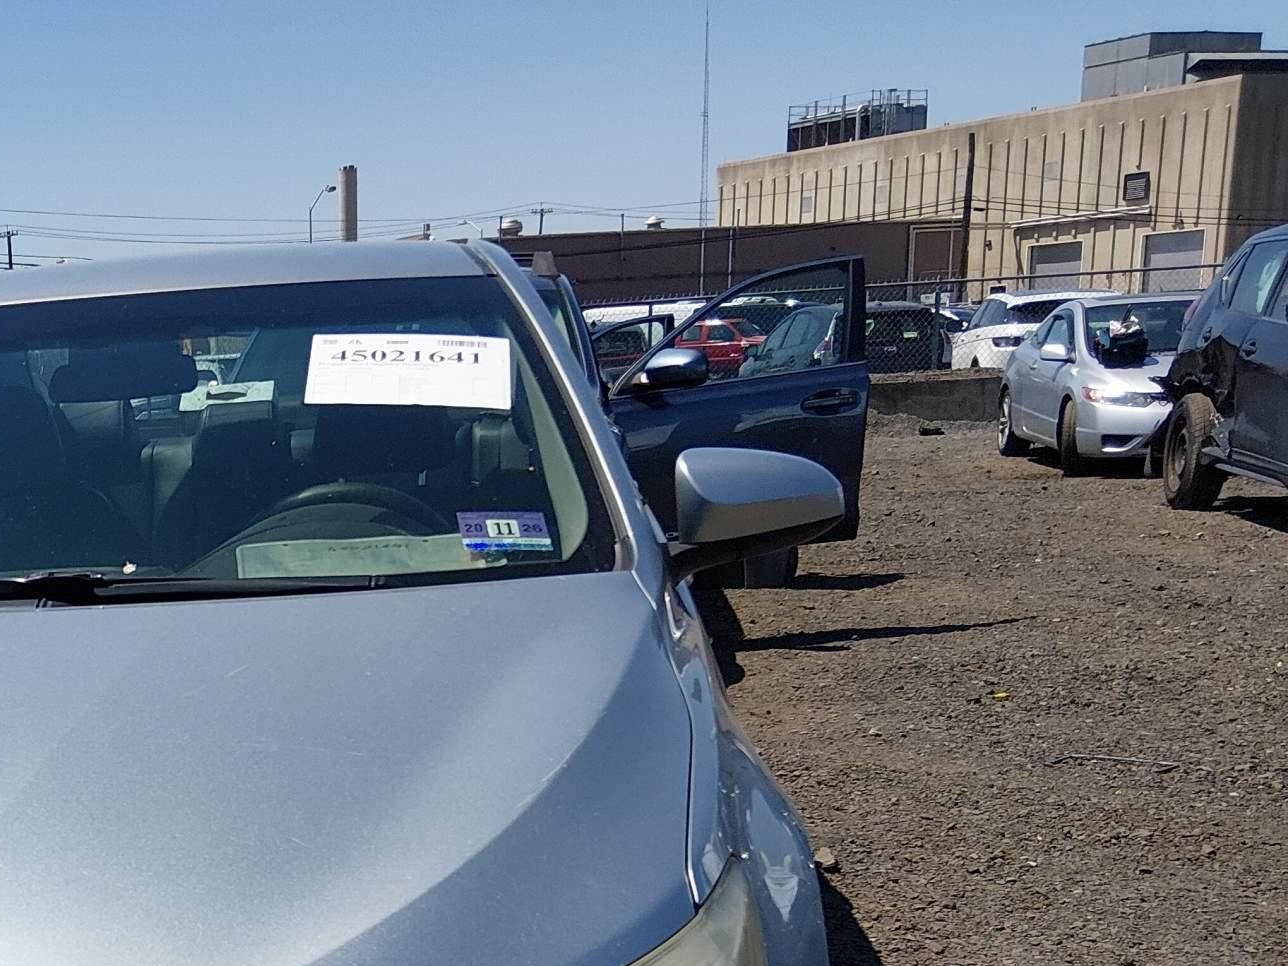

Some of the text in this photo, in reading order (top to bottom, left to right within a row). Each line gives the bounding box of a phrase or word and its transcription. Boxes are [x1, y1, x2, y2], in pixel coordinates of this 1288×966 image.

[331, 350, 481, 364] 45021641
[464, 522, 543, 536] 20 11 26
